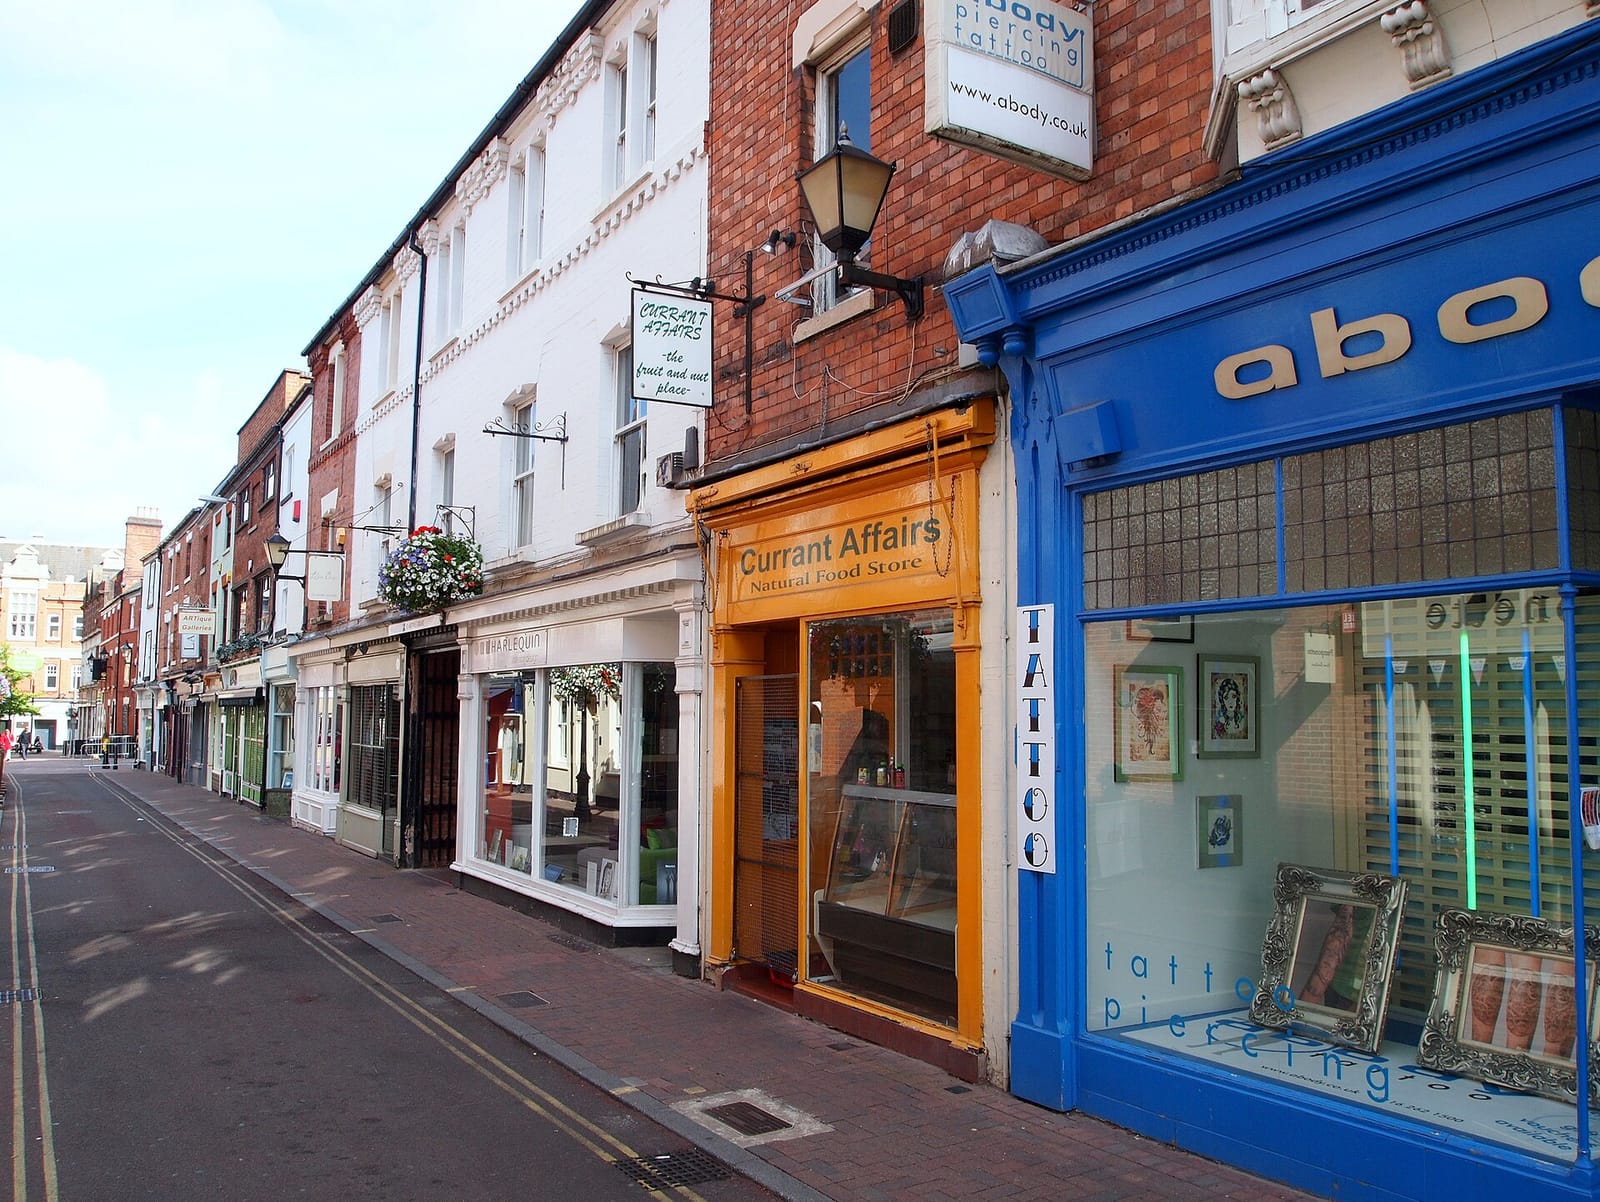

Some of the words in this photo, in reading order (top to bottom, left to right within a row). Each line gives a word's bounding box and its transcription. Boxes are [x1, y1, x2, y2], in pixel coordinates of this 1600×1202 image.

[954, 22, 1047, 69] tattoo
[956, 3, 1078, 67] piercing
[975, 0, 1080, 43] body
[950, 81, 1088, 139] www.abody.co.uk
[639, 302, 708, 326] CURRANT
[642, 319, 702, 341] AFFAIRS
[636, 362, 663, 378] fruit
[666, 368, 688, 381] and
[690, 372, 709, 382] nut
[740, 534, 832, 576] Currant
[839, 516, 941, 559] Affairs
[751, 571, 810, 593] Natural
[816, 564, 861, 583] Food
[867, 555, 923, 576] Store
[1022, 607, 1049, 868] TATTOO
[1104, 942, 1296, 1011] tattoo
[1104, 995, 1390, 1102] piercing
